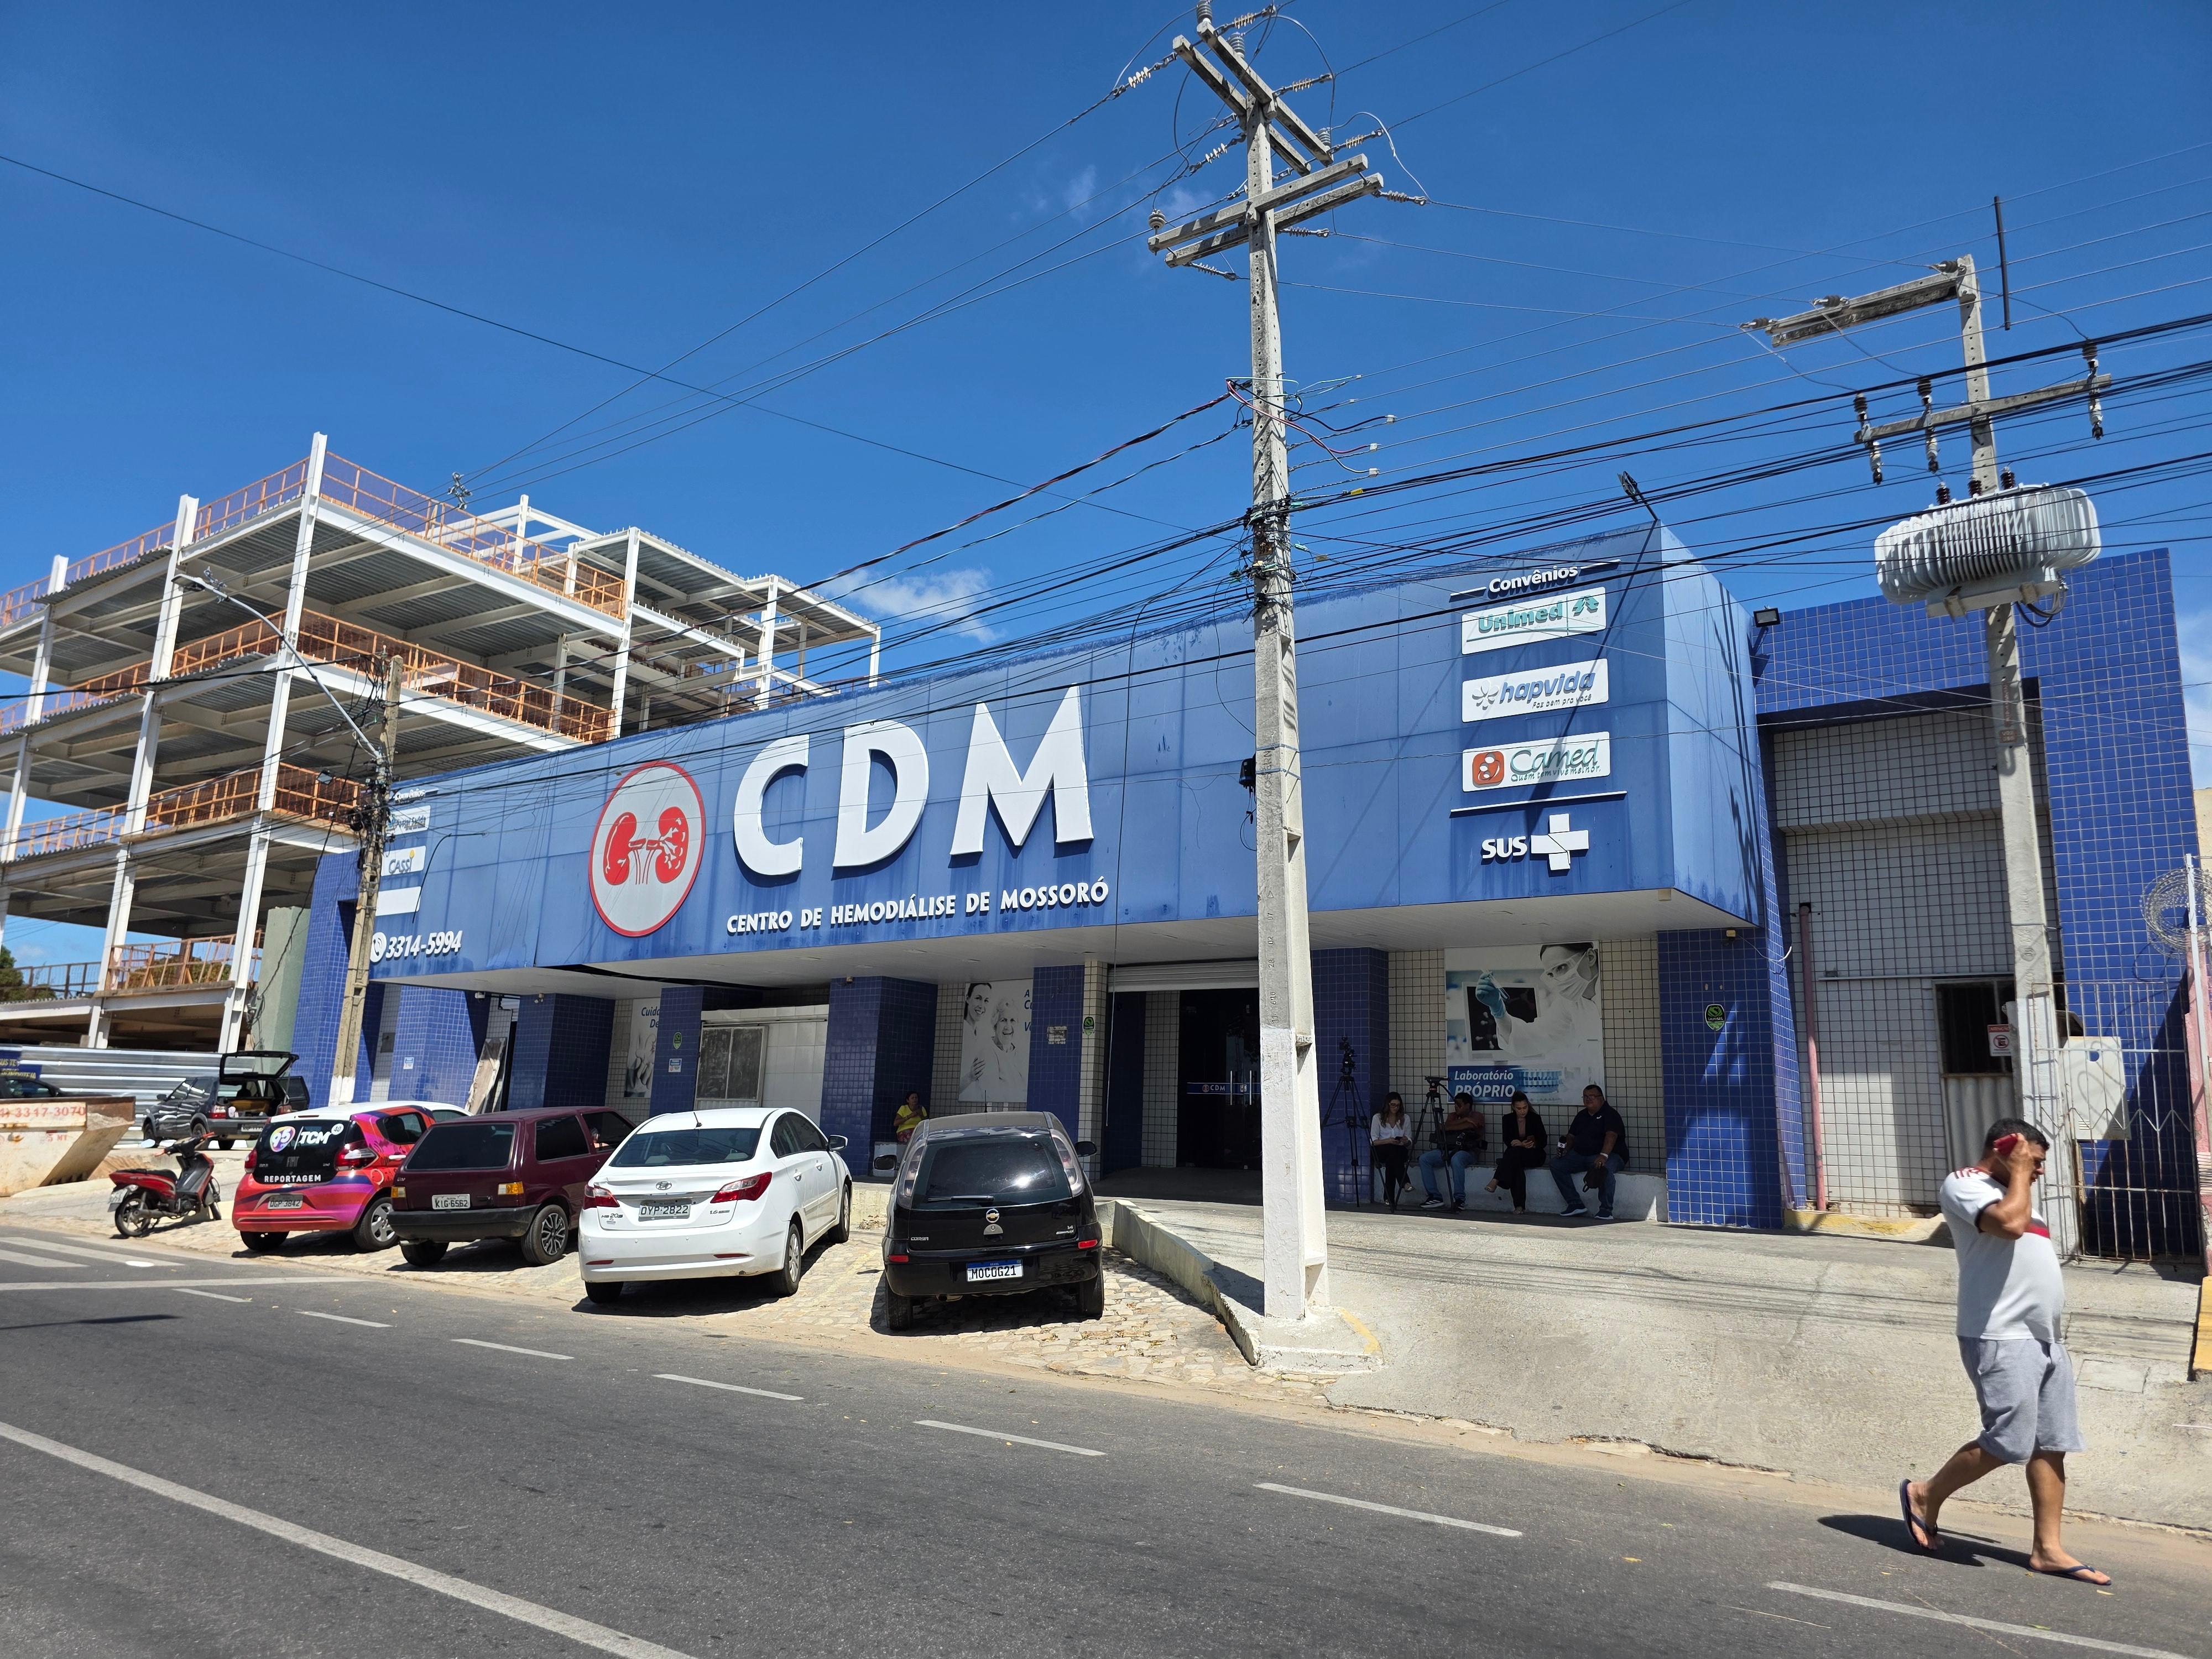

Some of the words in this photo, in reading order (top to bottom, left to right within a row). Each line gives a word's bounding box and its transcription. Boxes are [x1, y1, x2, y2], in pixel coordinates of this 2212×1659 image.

[1489, 566, 1578, 593] Convênios
[1479, 601, 1563, 632] Unimed
[1500, 671, 1595, 703] hapvida
[1510, 738, 1599, 774] Camed
[734, 685, 1094, 875] CDM
[1482, 836, 1527, 859] SUS
[389, 854, 413, 874] CASSI
[727, 910, 792, 933] CENTRO
[801, 907, 822, 928] DE
[831, 893, 956, 924] HEMODIÁLISE
[966, 891, 990, 913] DE
[1000, 876, 1109, 910] MOSSORÓ
[385, 930, 462, 958] 3314-5994
[1024, 989, 1030, 998] A
[1454, 1070, 1514, 1080] Laboratório
[1455, 1082, 1515, 1097] PRÓPRIO
[299, 1131, 330, 1144] TCM
